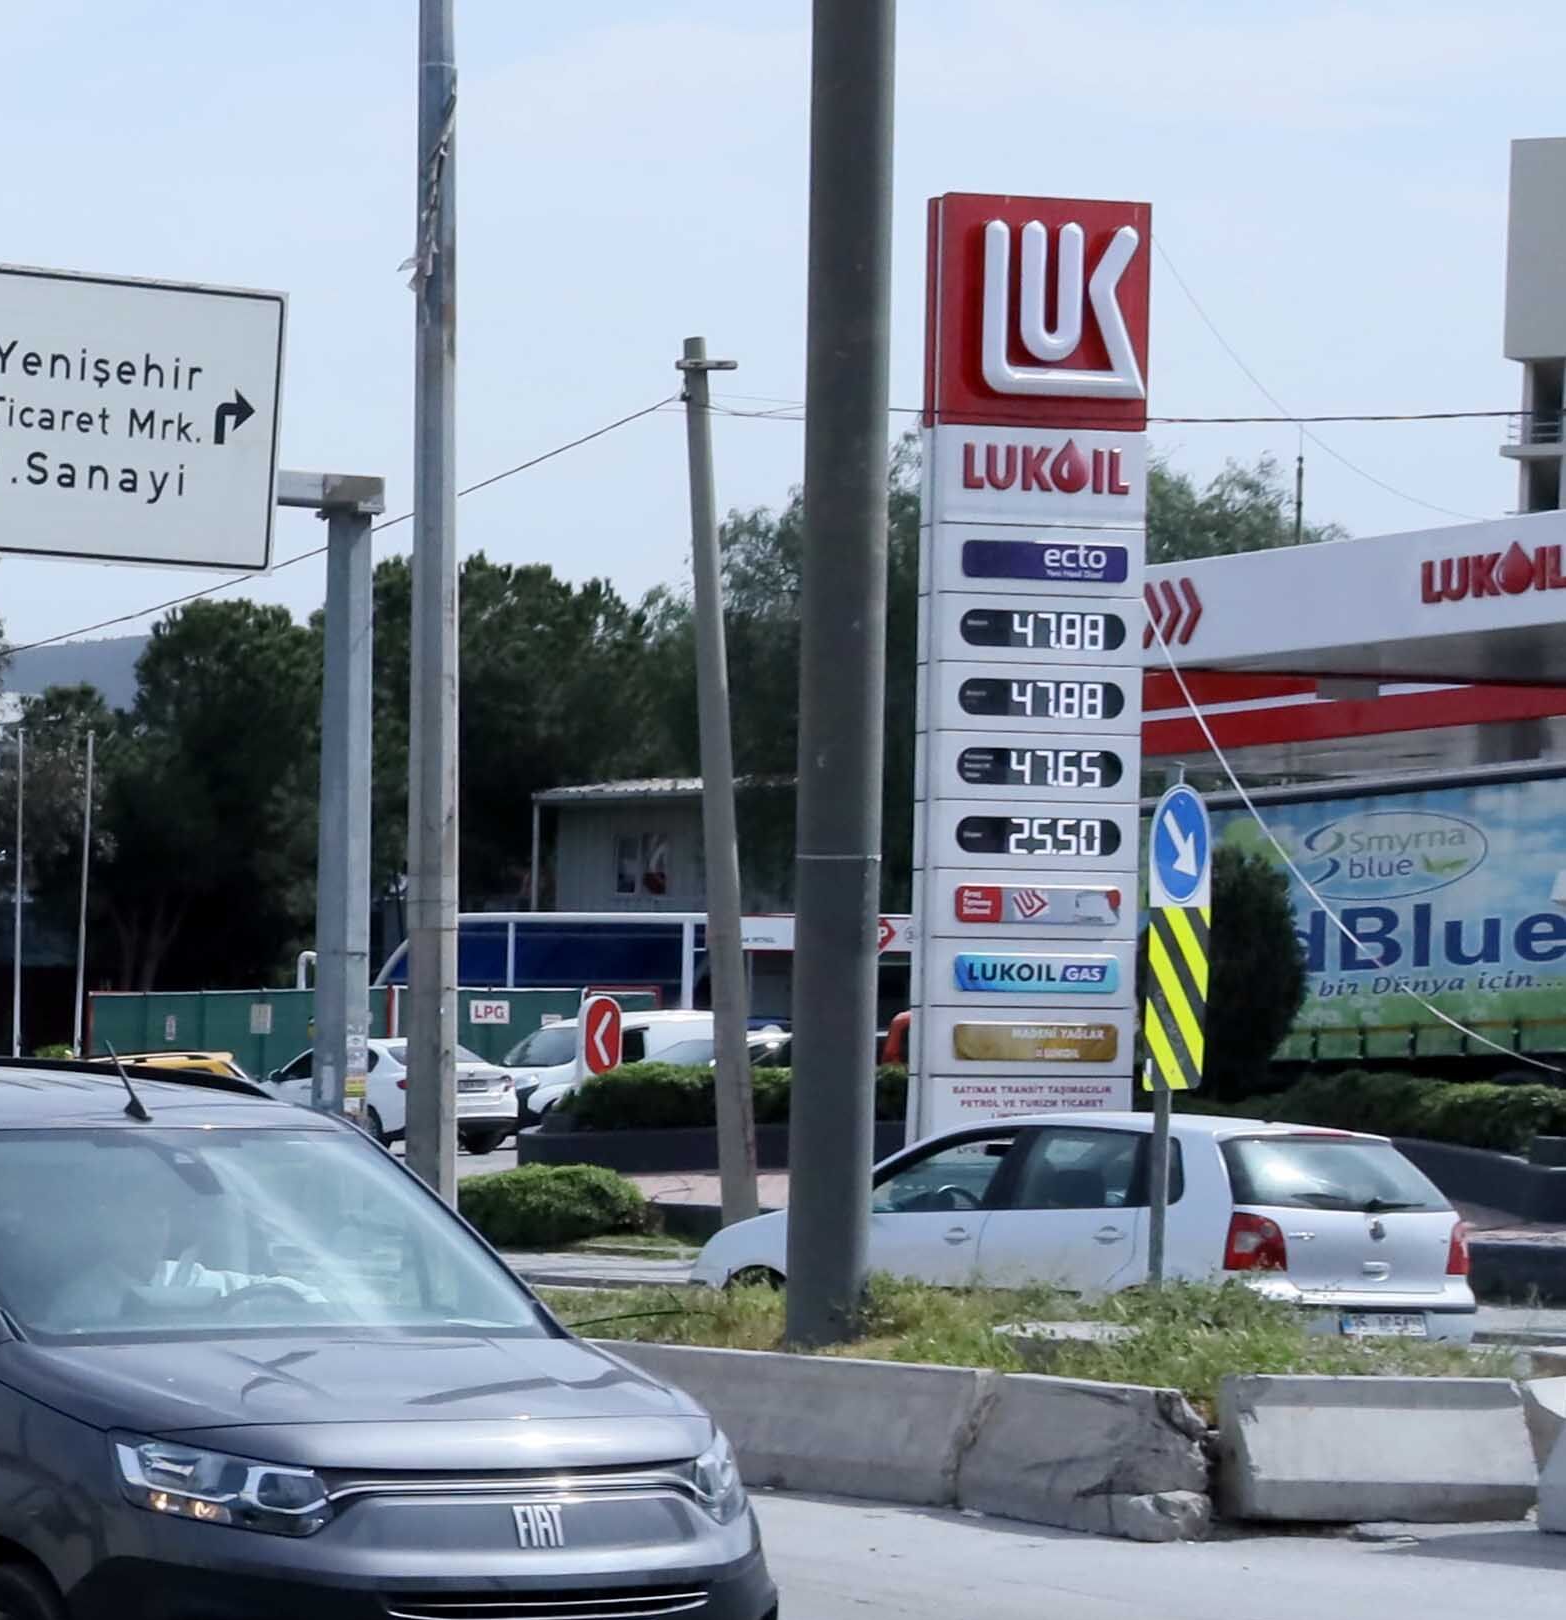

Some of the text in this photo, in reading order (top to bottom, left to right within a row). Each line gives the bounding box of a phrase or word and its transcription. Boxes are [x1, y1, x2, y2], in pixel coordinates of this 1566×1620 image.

[128, 407, 201, 443] Mrk.
[963, 437, 1130, 495] LUKOIL
[1043, 545, 1108, 569] ecto
[1421, 540, 1566, 604] LUKOIL
[1010, 750, 1102, 788] 47.65
[1009, 818, 1101, 856] 25.50
[1343, 827, 1467, 855] Smyrna
[1349, 856, 1414, 879] blue
[1295, 903, 1566, 973] dBlue
[967, 962, 1102, 982] LUKOIL GAS
[1318, 977, 1358, 998] bir
[1372, 974, 1466, 996] Dünya
[474, 1005, 505, 1019] LPG
[512, 1504, 565, 1548] FIAT
